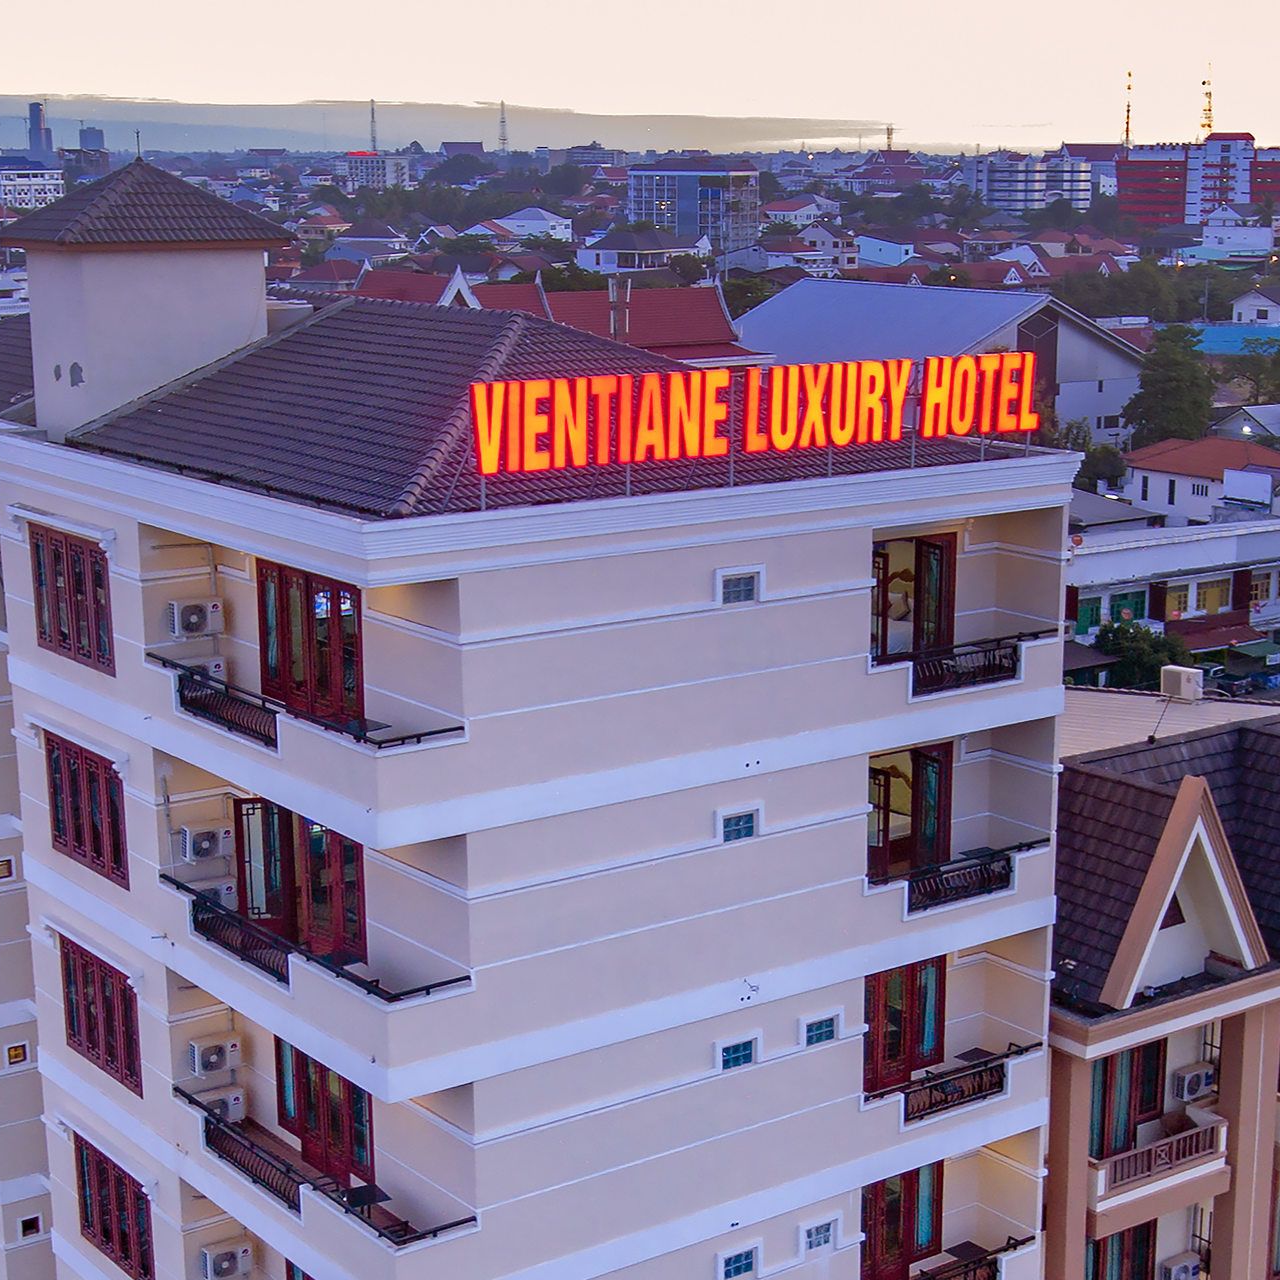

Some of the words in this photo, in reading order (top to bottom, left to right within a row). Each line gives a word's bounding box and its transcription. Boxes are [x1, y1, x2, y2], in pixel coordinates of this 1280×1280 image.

[471, 369, 732, 475] VIENTIANE
[744, 358, 914, 453] LUXURY
[921, 352, 1039, 438] HOTEL
